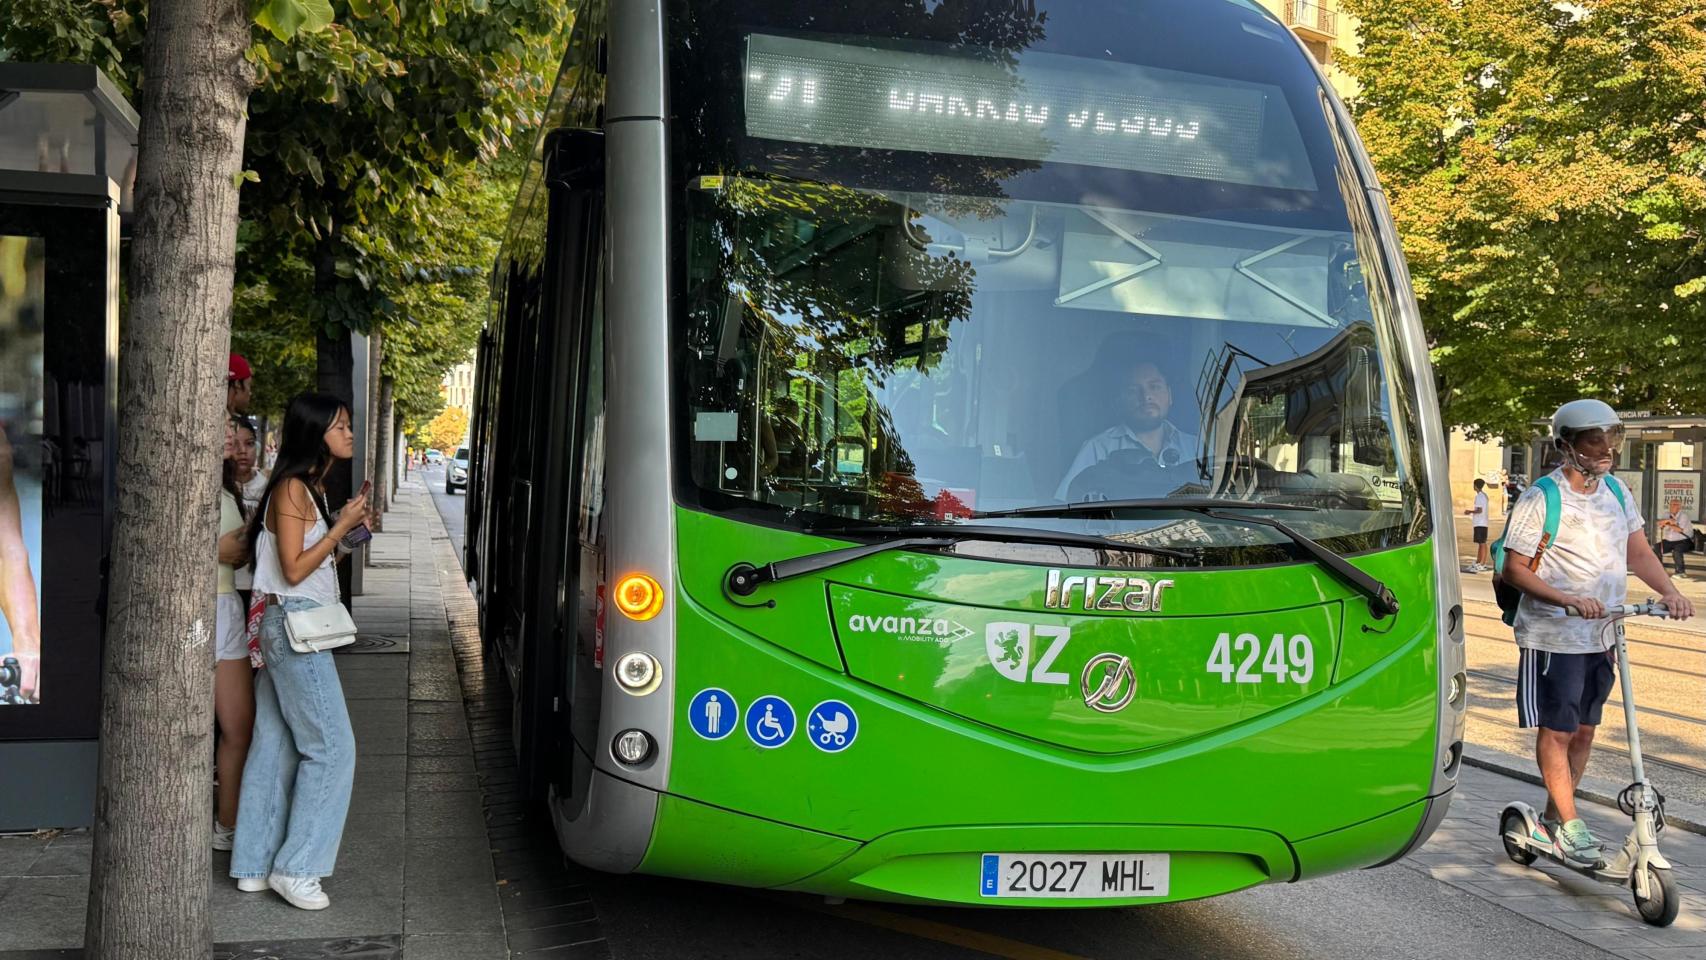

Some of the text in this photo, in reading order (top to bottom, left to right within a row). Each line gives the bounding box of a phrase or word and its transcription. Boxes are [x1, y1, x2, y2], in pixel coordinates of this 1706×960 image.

[1045, 569, 1174, 611] Irizar
[849, 614, 949, 636] avanza
[1206, 632, 1314, 684] 4249
[986, 879, 993, 888] E
[1009, 860, 1154, 892] 2027 MHL
